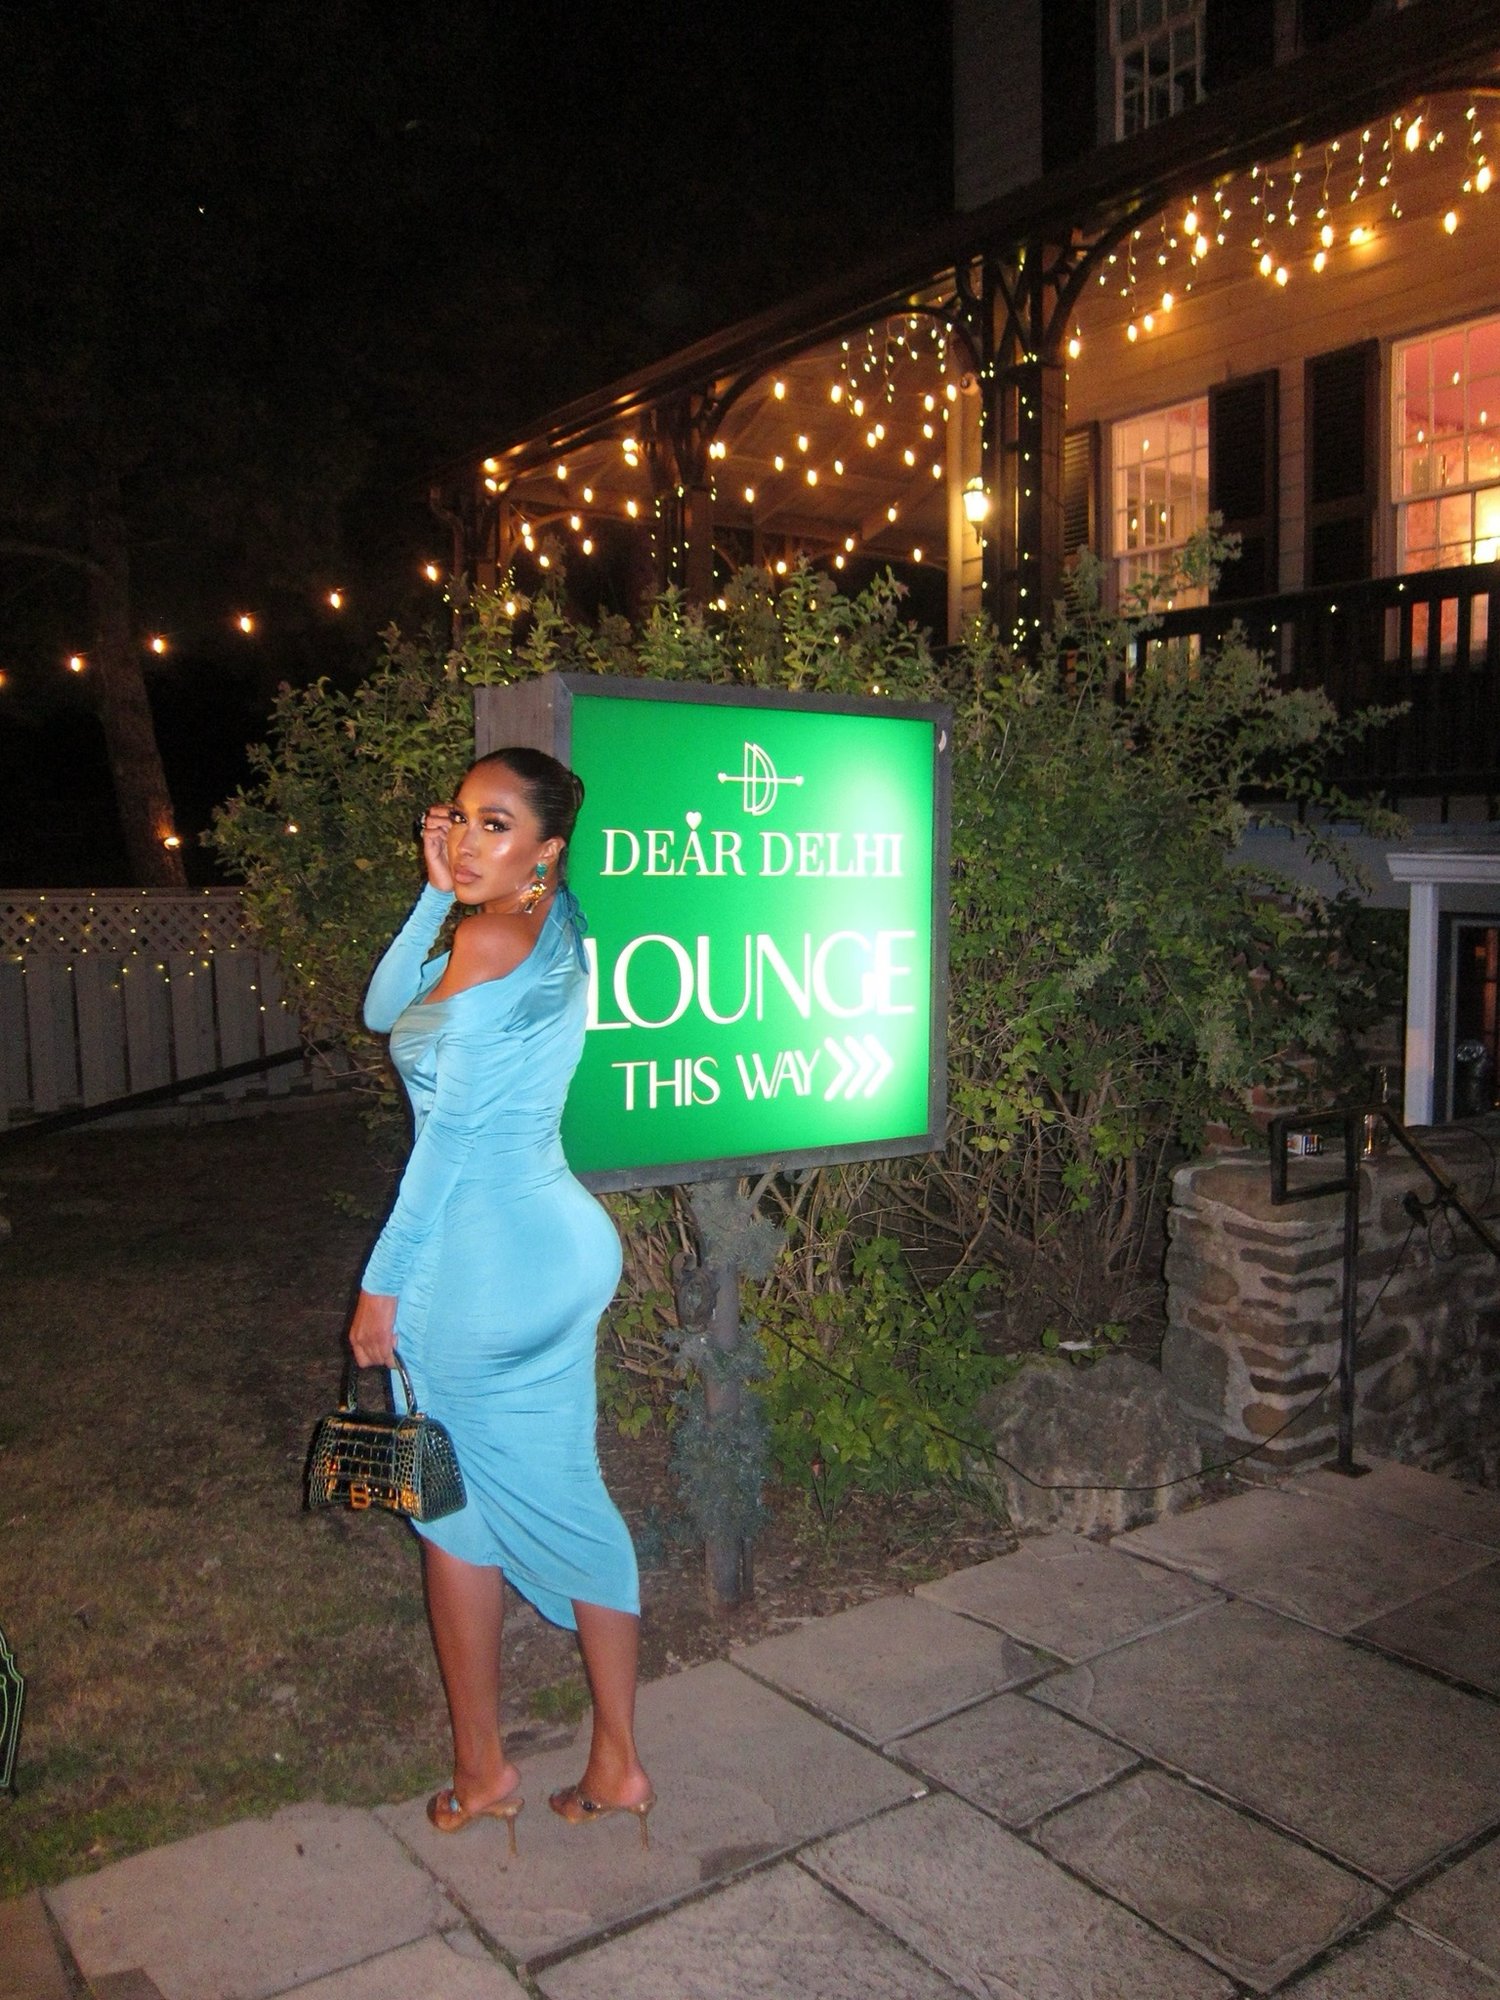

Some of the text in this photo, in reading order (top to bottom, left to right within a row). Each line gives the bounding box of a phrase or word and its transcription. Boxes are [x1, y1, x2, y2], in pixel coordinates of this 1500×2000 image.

[600, 828, 904, 877] DEAR DELHI
[585, 931, 916, 1031] LOUNGE
[611, 1050, 820, 1111] THIS WAY
